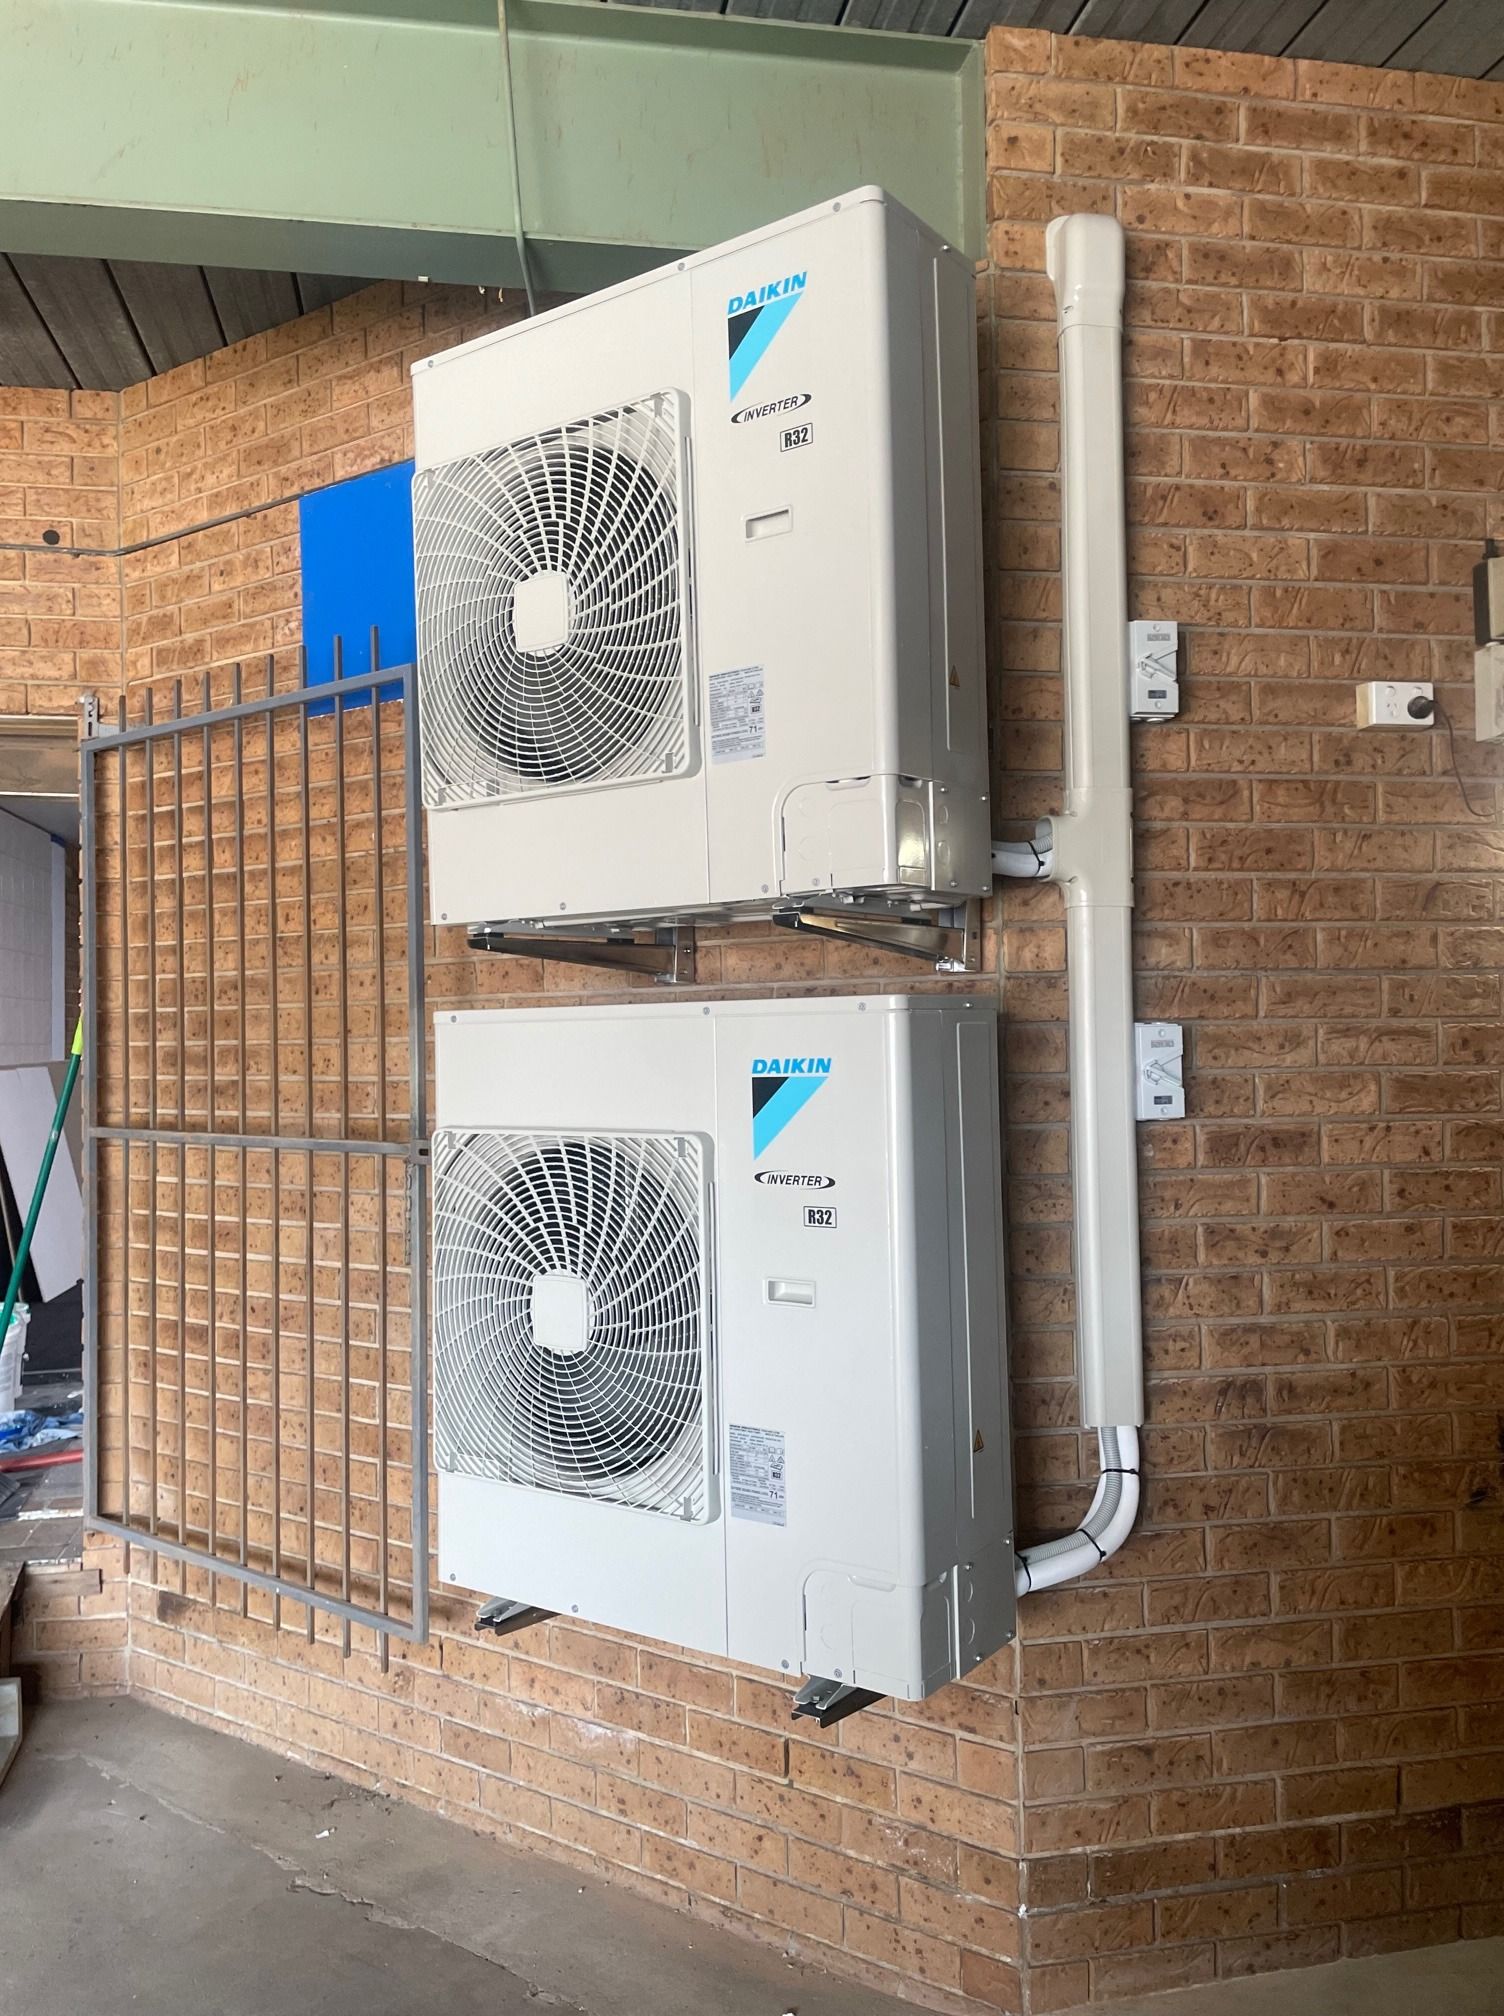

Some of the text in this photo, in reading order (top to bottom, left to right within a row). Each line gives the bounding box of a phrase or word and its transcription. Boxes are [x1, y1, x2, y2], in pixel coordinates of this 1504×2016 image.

[728, 271, 807, 315] DAIKIN
[744, 395, 798, 423] INVERTER
[784, 427, 808, 448] R32
[749, 725, 757, 734] 71
[752, 1058, 832, 1074] DAIKIN
[767, 1174, 822, 1187] INVERTER
[808, 1209, 832, 1225] R32
[769, 1490, 778, 1499] 71
